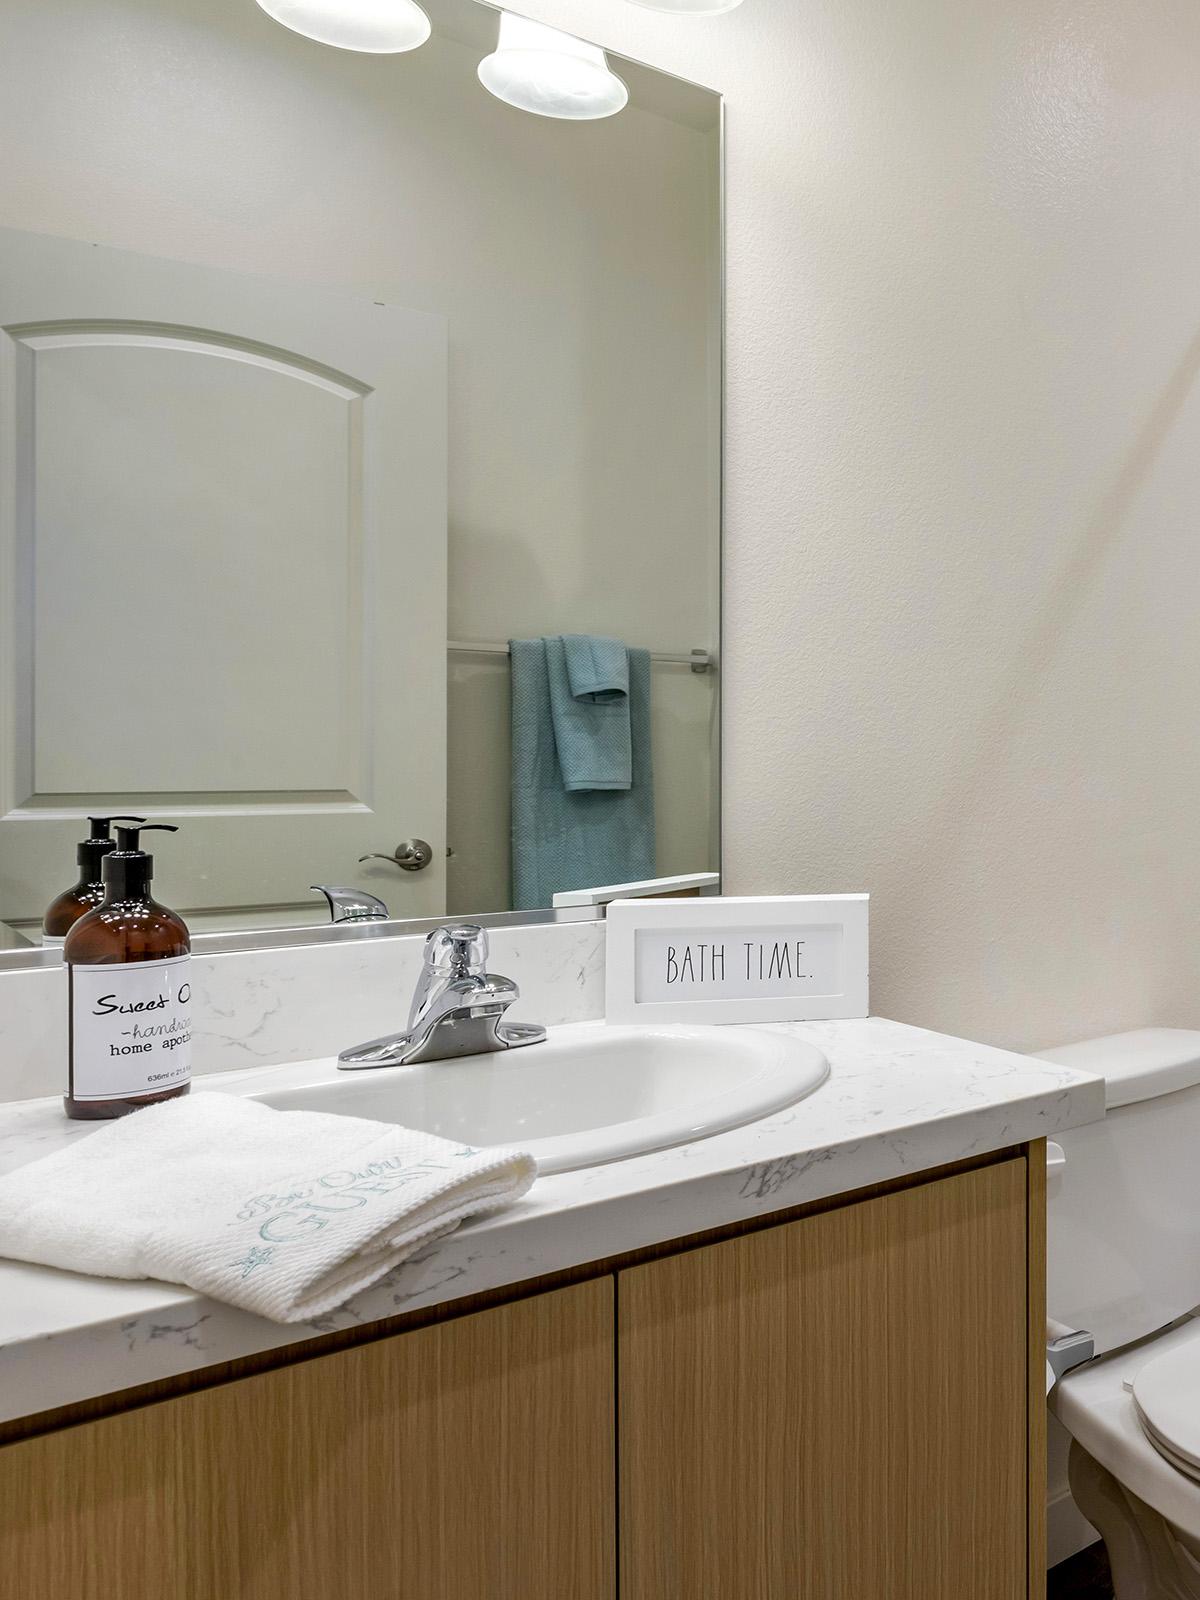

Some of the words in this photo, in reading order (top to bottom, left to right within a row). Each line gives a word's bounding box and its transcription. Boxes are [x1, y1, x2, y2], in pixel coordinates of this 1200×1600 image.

[666, 944, 725, 983] BATH
[743, 941, 813, 980] TIME.
[92, 994, 169, 1015] Sweet
[110, 1043, 152, 1056] home
[320, 1156, 401, 1187] Our
[259, 1159, 449, 1242] GUEST
